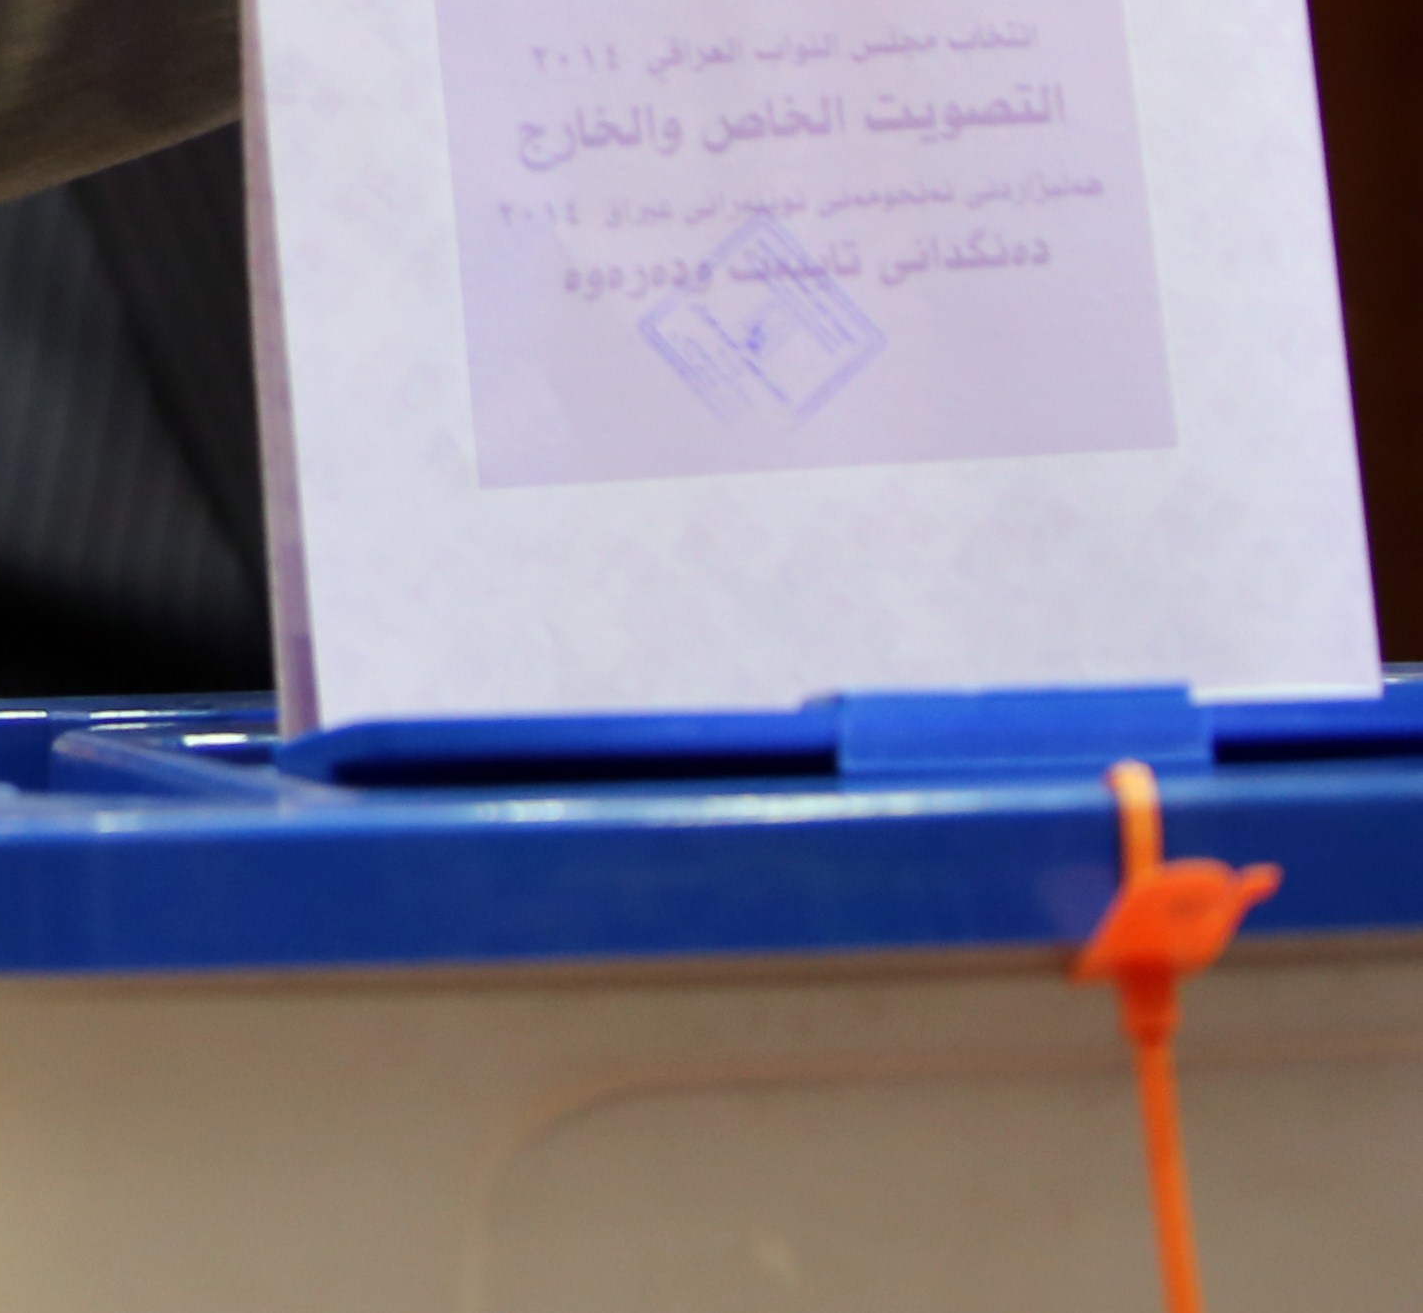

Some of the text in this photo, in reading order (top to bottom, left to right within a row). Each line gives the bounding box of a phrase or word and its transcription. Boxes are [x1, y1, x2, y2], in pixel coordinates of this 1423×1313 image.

[514, 81, 1066, 172] التصويت الخاص والخارج
